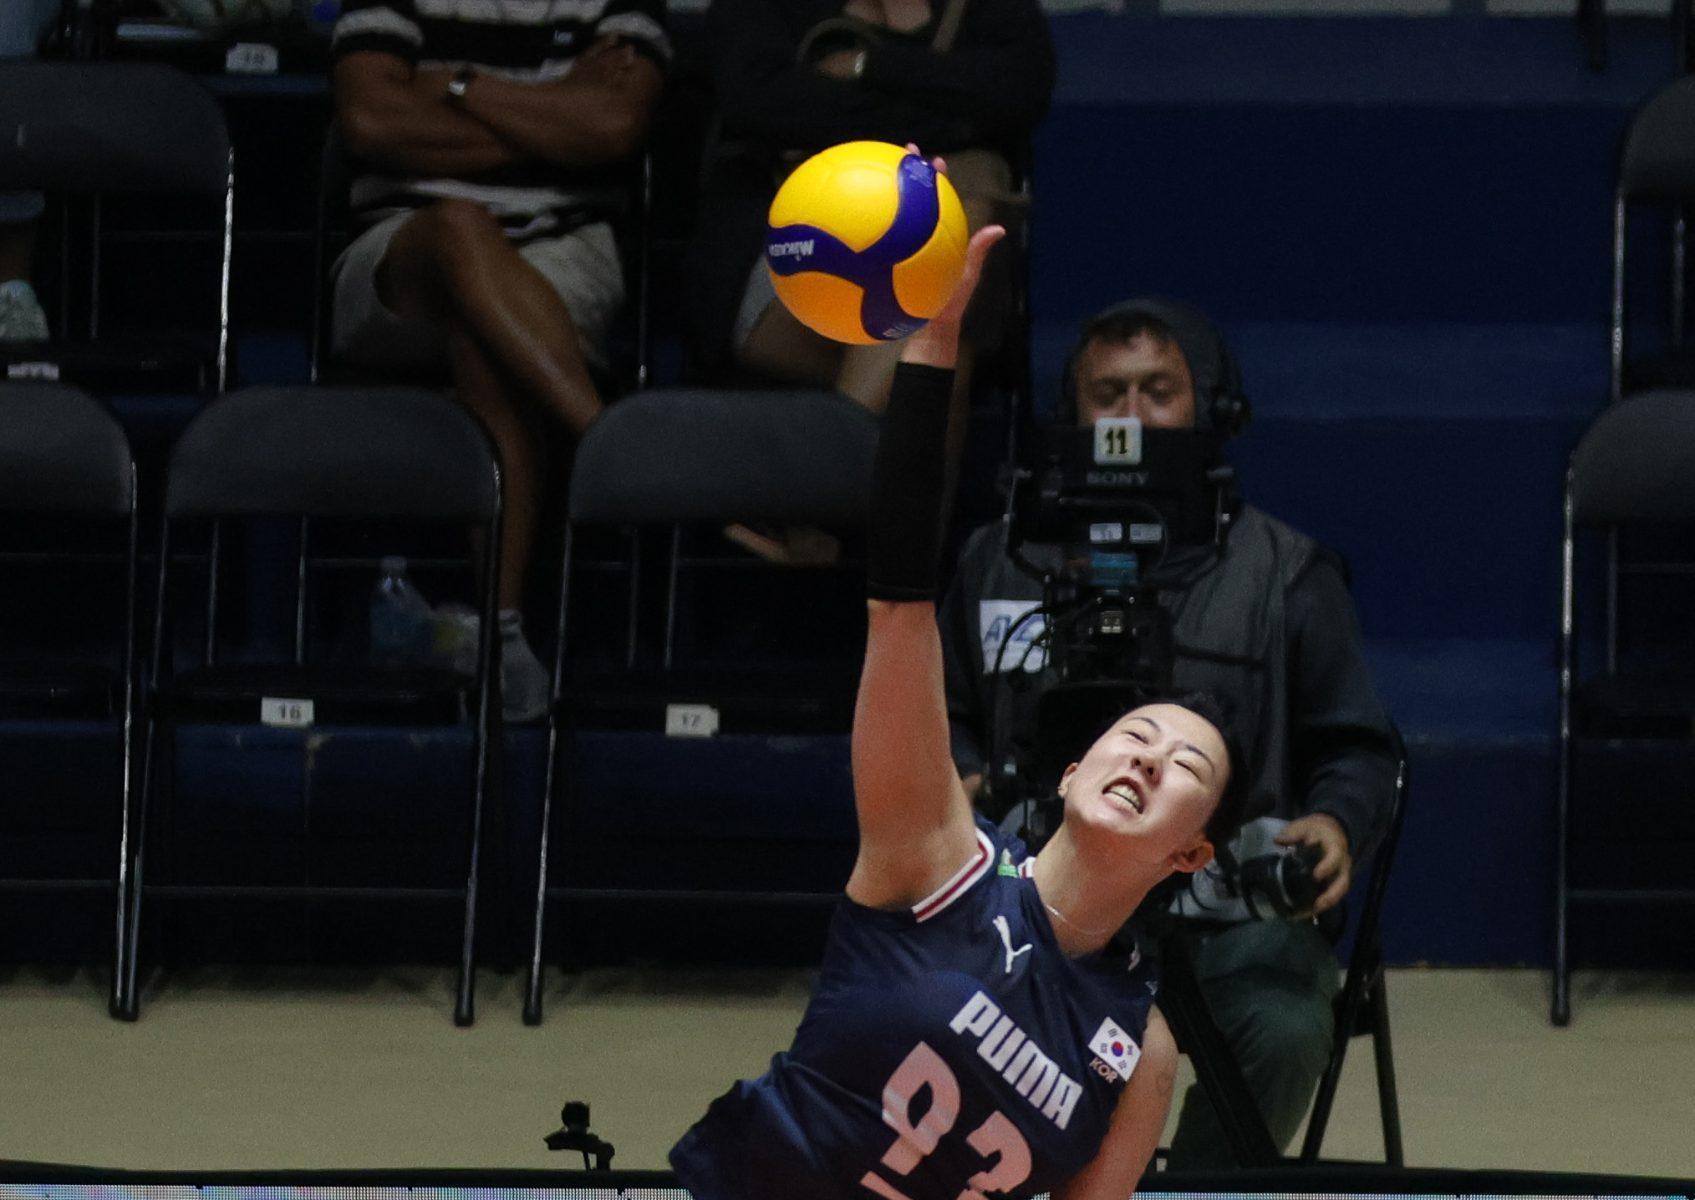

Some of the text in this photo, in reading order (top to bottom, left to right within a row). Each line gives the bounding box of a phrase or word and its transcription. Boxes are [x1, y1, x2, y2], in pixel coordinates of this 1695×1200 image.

[1104, 425, 1128, 455] 11
[1086, 470, 1150, 486] SONY
[279, 702, 303, 720] 16
[949, 990, 1083, 1130] PUMA
[1089, 1056, 1118, 1084] KOR
